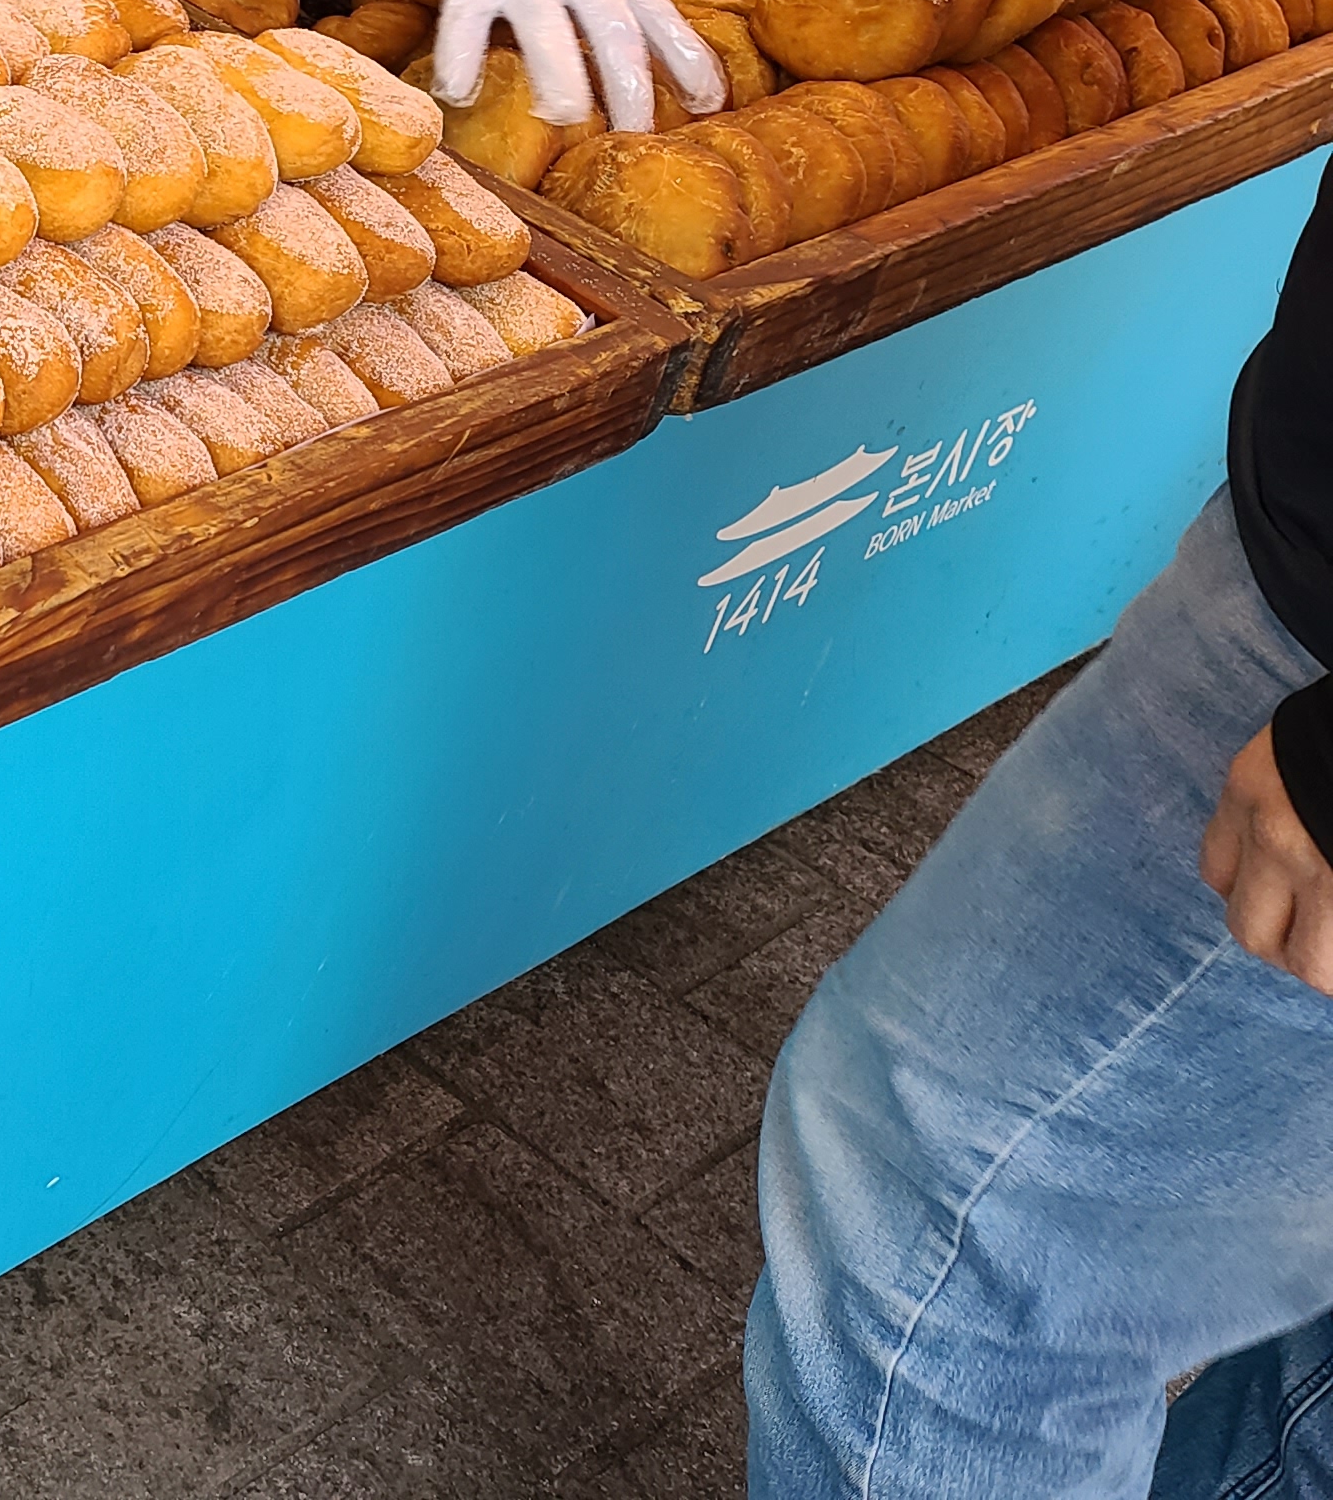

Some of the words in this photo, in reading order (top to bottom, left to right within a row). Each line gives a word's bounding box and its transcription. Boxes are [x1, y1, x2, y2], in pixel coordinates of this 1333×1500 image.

[882, 398, 1037, 518] 본시장
[864, 510, 927, 560] BORN
[926, 478, 997, 530] Market
[703, 546, 825, 654] 1414
